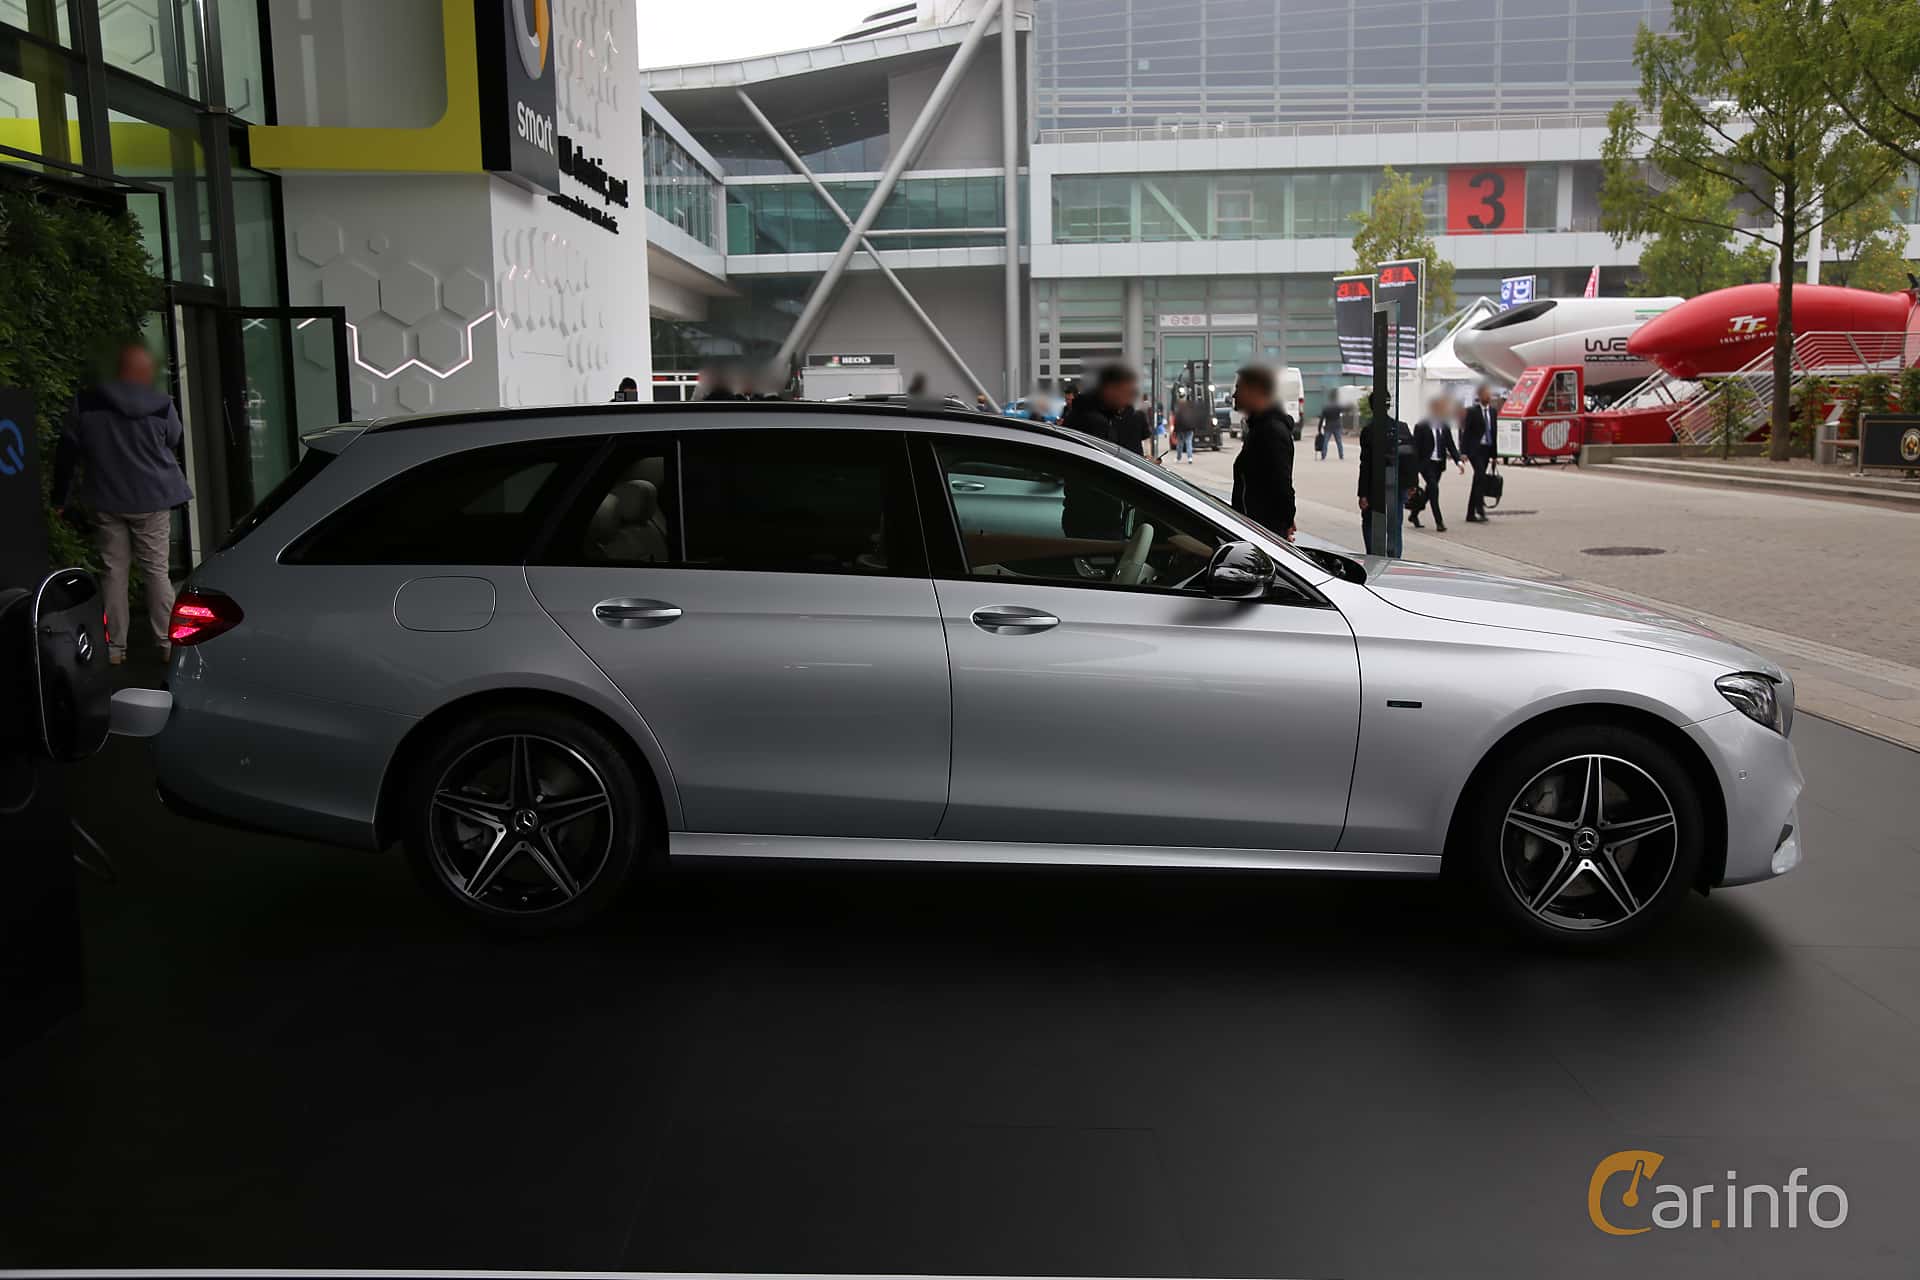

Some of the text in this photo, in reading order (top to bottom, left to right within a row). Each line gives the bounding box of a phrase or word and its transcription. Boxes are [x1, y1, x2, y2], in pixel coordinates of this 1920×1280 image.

[517, 101, 553, 154] smart
[1467, 172, 1505, 231] 3
[1729, 315, 1767, 333] TT
